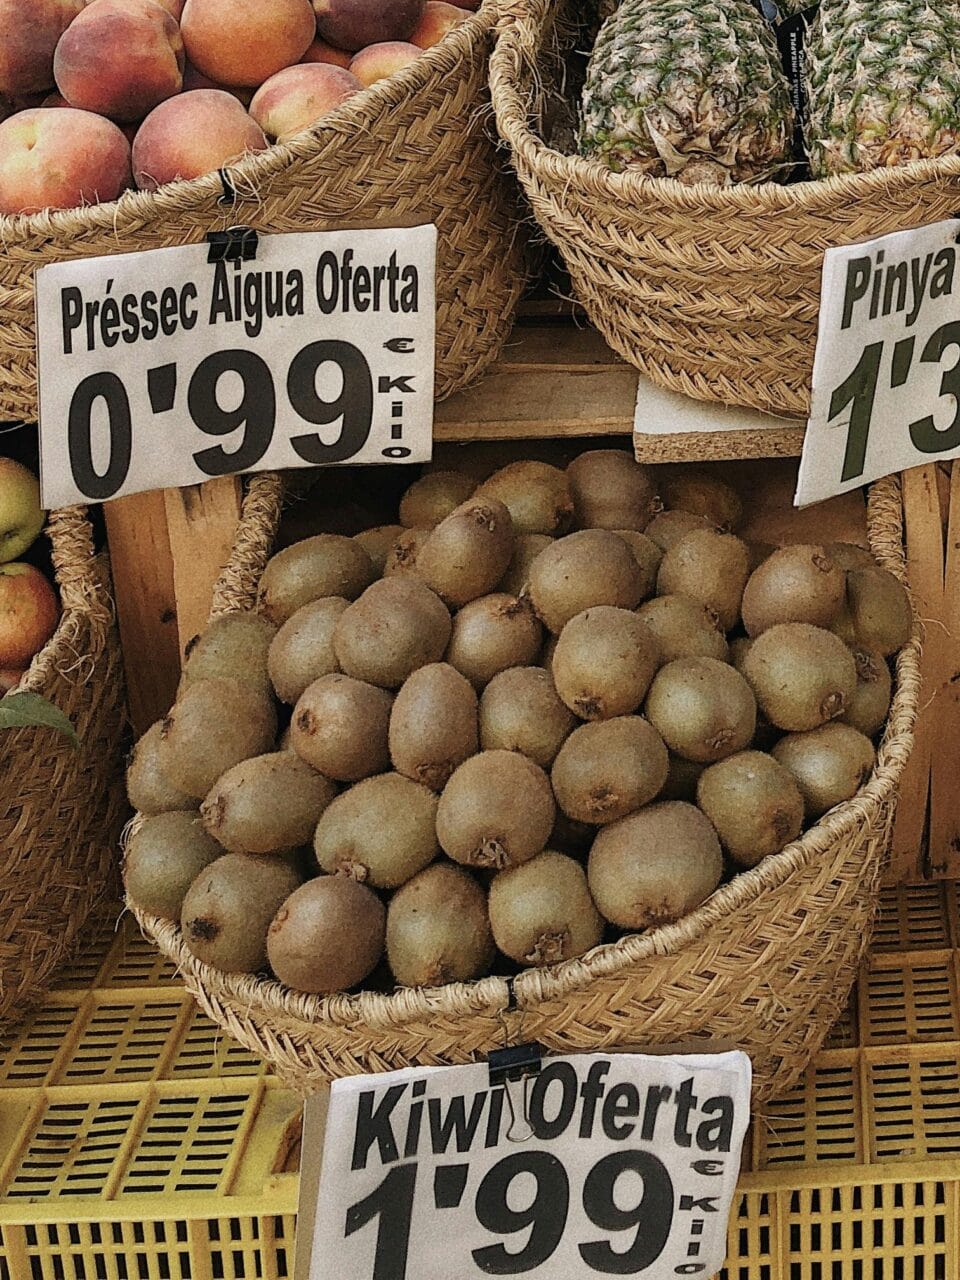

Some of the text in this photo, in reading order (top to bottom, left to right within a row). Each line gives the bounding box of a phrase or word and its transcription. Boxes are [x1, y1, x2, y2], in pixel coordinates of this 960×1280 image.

[790, 32, 798, 72] PINEAPPLE
[61, 248, 419, 354] Préssec Aigua Oferta
[841, 246, 956, 330] Pinya
[68, 338, 374, 500] 0'99
[377, 375, 417, 459] Kilo
[351, 1061, 735, 1171] Kiwi Oferta
[344, 1149, 675, 1280] 1'99
